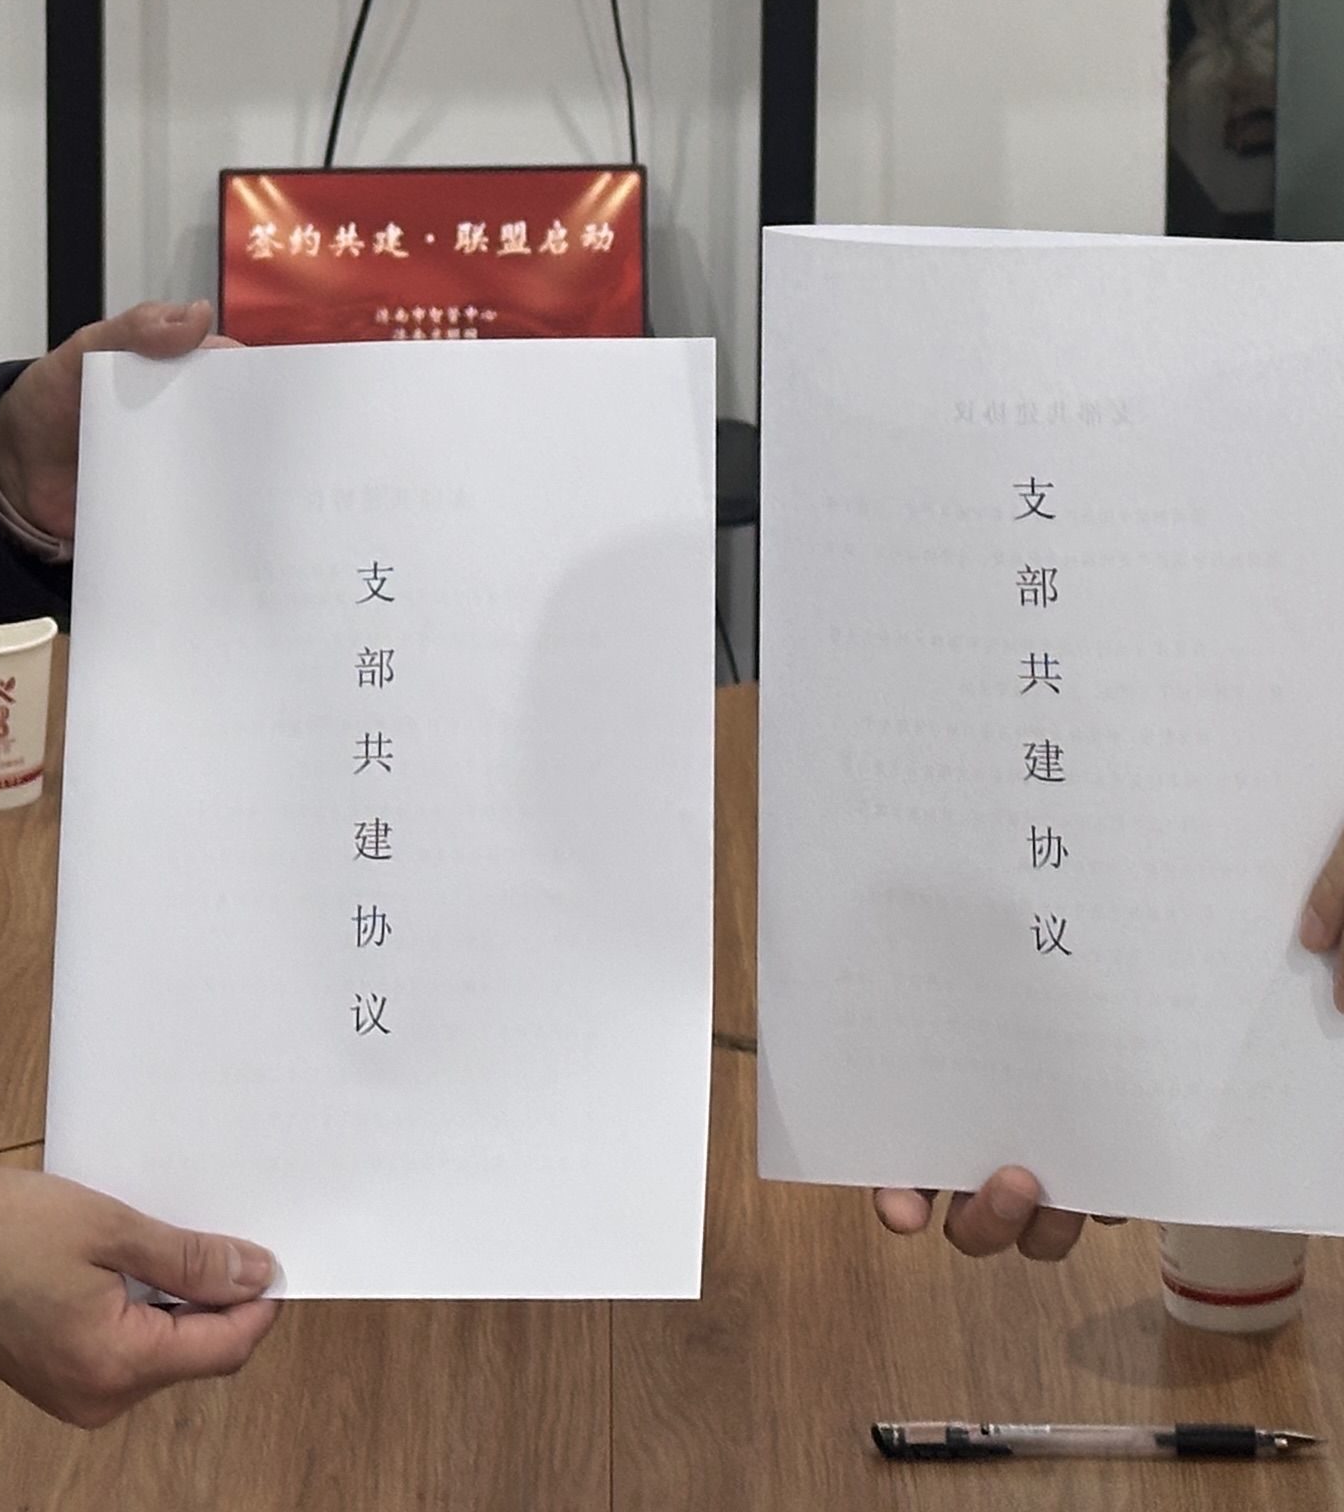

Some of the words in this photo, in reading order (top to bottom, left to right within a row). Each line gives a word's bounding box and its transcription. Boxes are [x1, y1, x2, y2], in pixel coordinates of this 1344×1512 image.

[246, 218, 615, 260] 签约共建·联盟启动
[350, 559, 396, 1038] 支部共建协议
[1013, 475, 1072, 958] 支部共建协议
